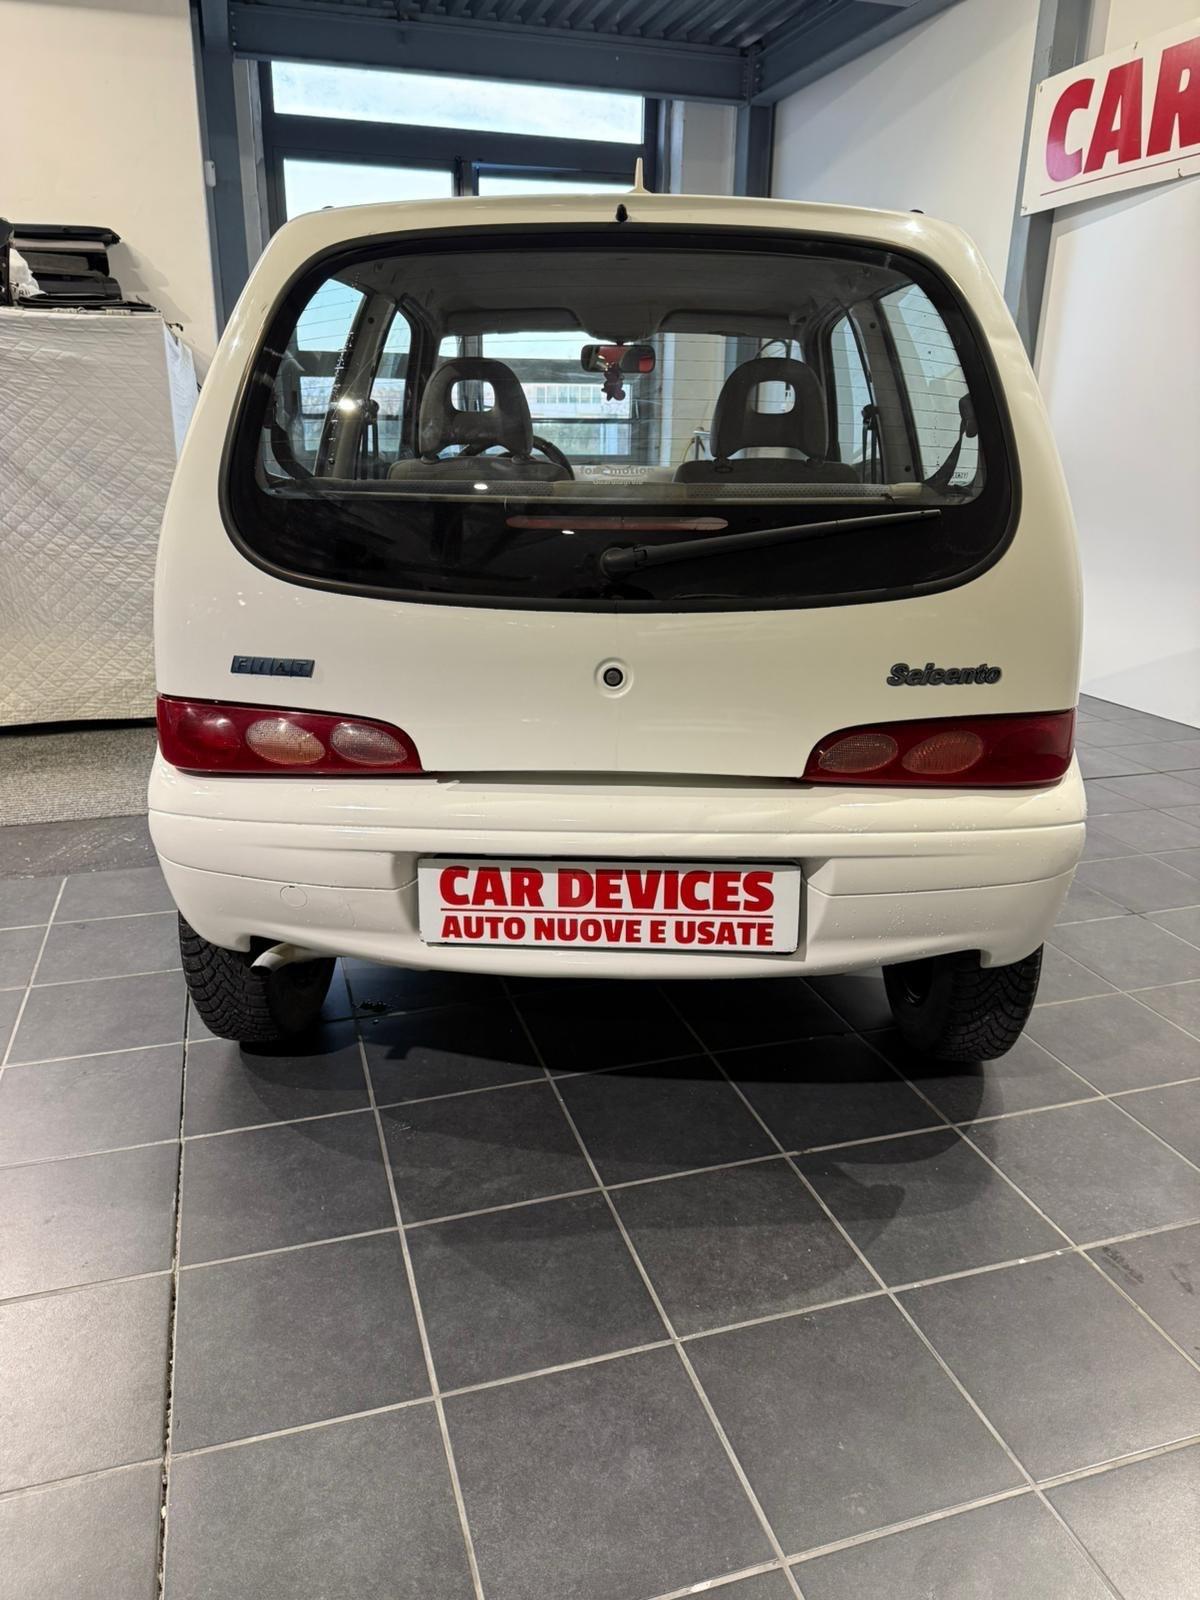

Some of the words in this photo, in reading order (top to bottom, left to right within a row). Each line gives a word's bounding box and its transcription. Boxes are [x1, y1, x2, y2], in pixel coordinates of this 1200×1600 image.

[1045, 36, 1200, 182] CAR
[234, 656, 312, 677] FIAT
[886, 662, 1002, 686] Seicento
[439, 866, 544, 907] CAR
[557, 868, 774, 912] DEVICES
[441, 915, 526, 940] AUTO
[534, 917, 642, 943] NUOVE
[649, 920, 667, 944] E
[674, 920, 774, 946] USATE
